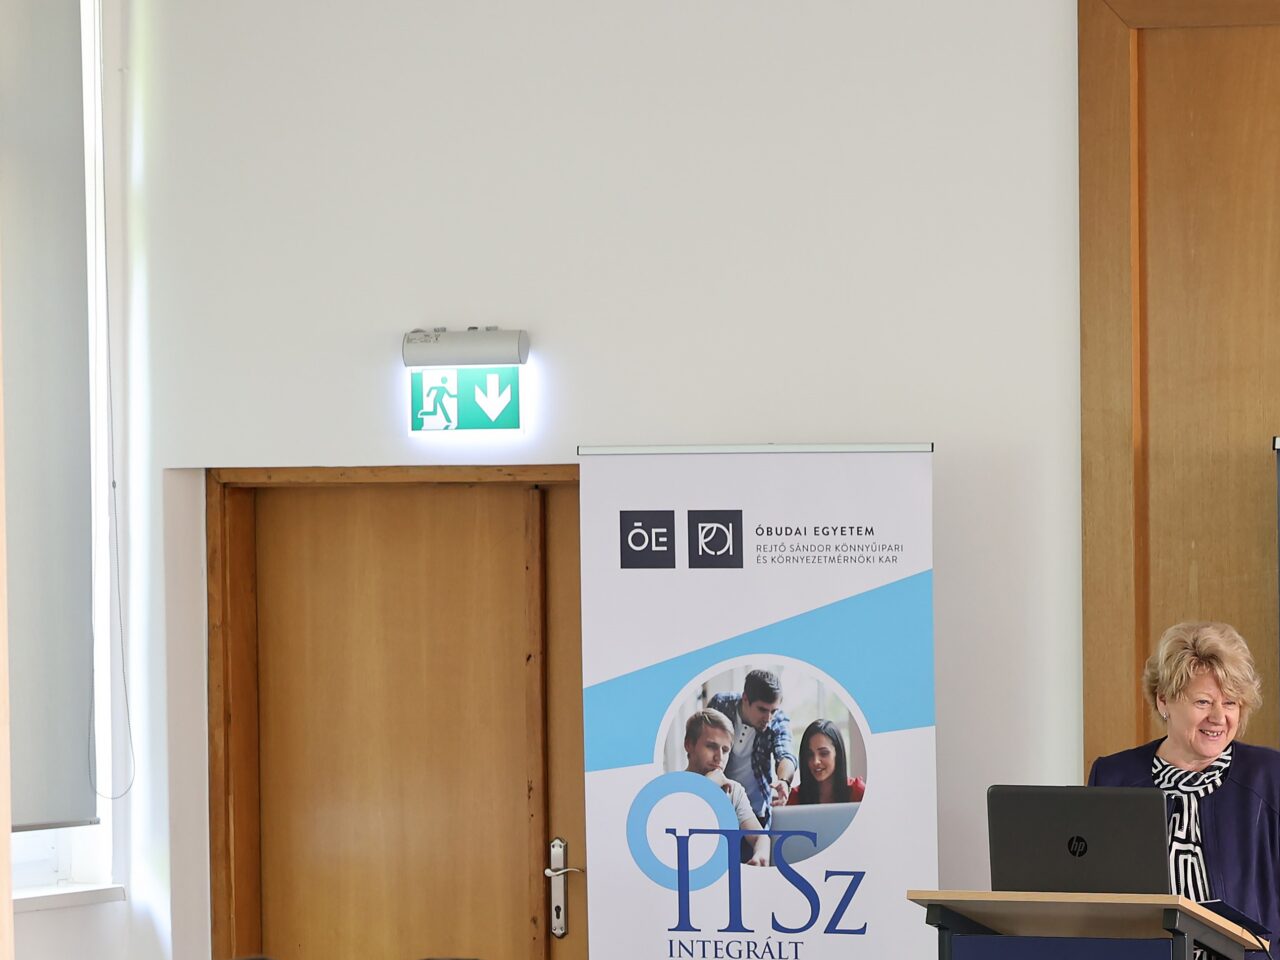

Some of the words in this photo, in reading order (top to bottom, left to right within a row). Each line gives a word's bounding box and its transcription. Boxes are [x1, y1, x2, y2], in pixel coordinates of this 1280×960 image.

[755, 523, 808, 537] ÓBUDAI
[813, 525, 875, 537] EGYETEM
[756, 542, 787, 553] REJTŐ
[789, 542, 832, 553] SÁNDOR
[835, 542, 904, 553] KÖNNYŰIPARI
[756, 553, 767, 564] ÉS
[770, 554, 875, 564] KÖRNYEZETMÉRNÖKI
[878, 555, 898, 564] KAR
[1068, 835, 1088, 858] hp
[668, 936, 804, 960] INTEGRÁLT
